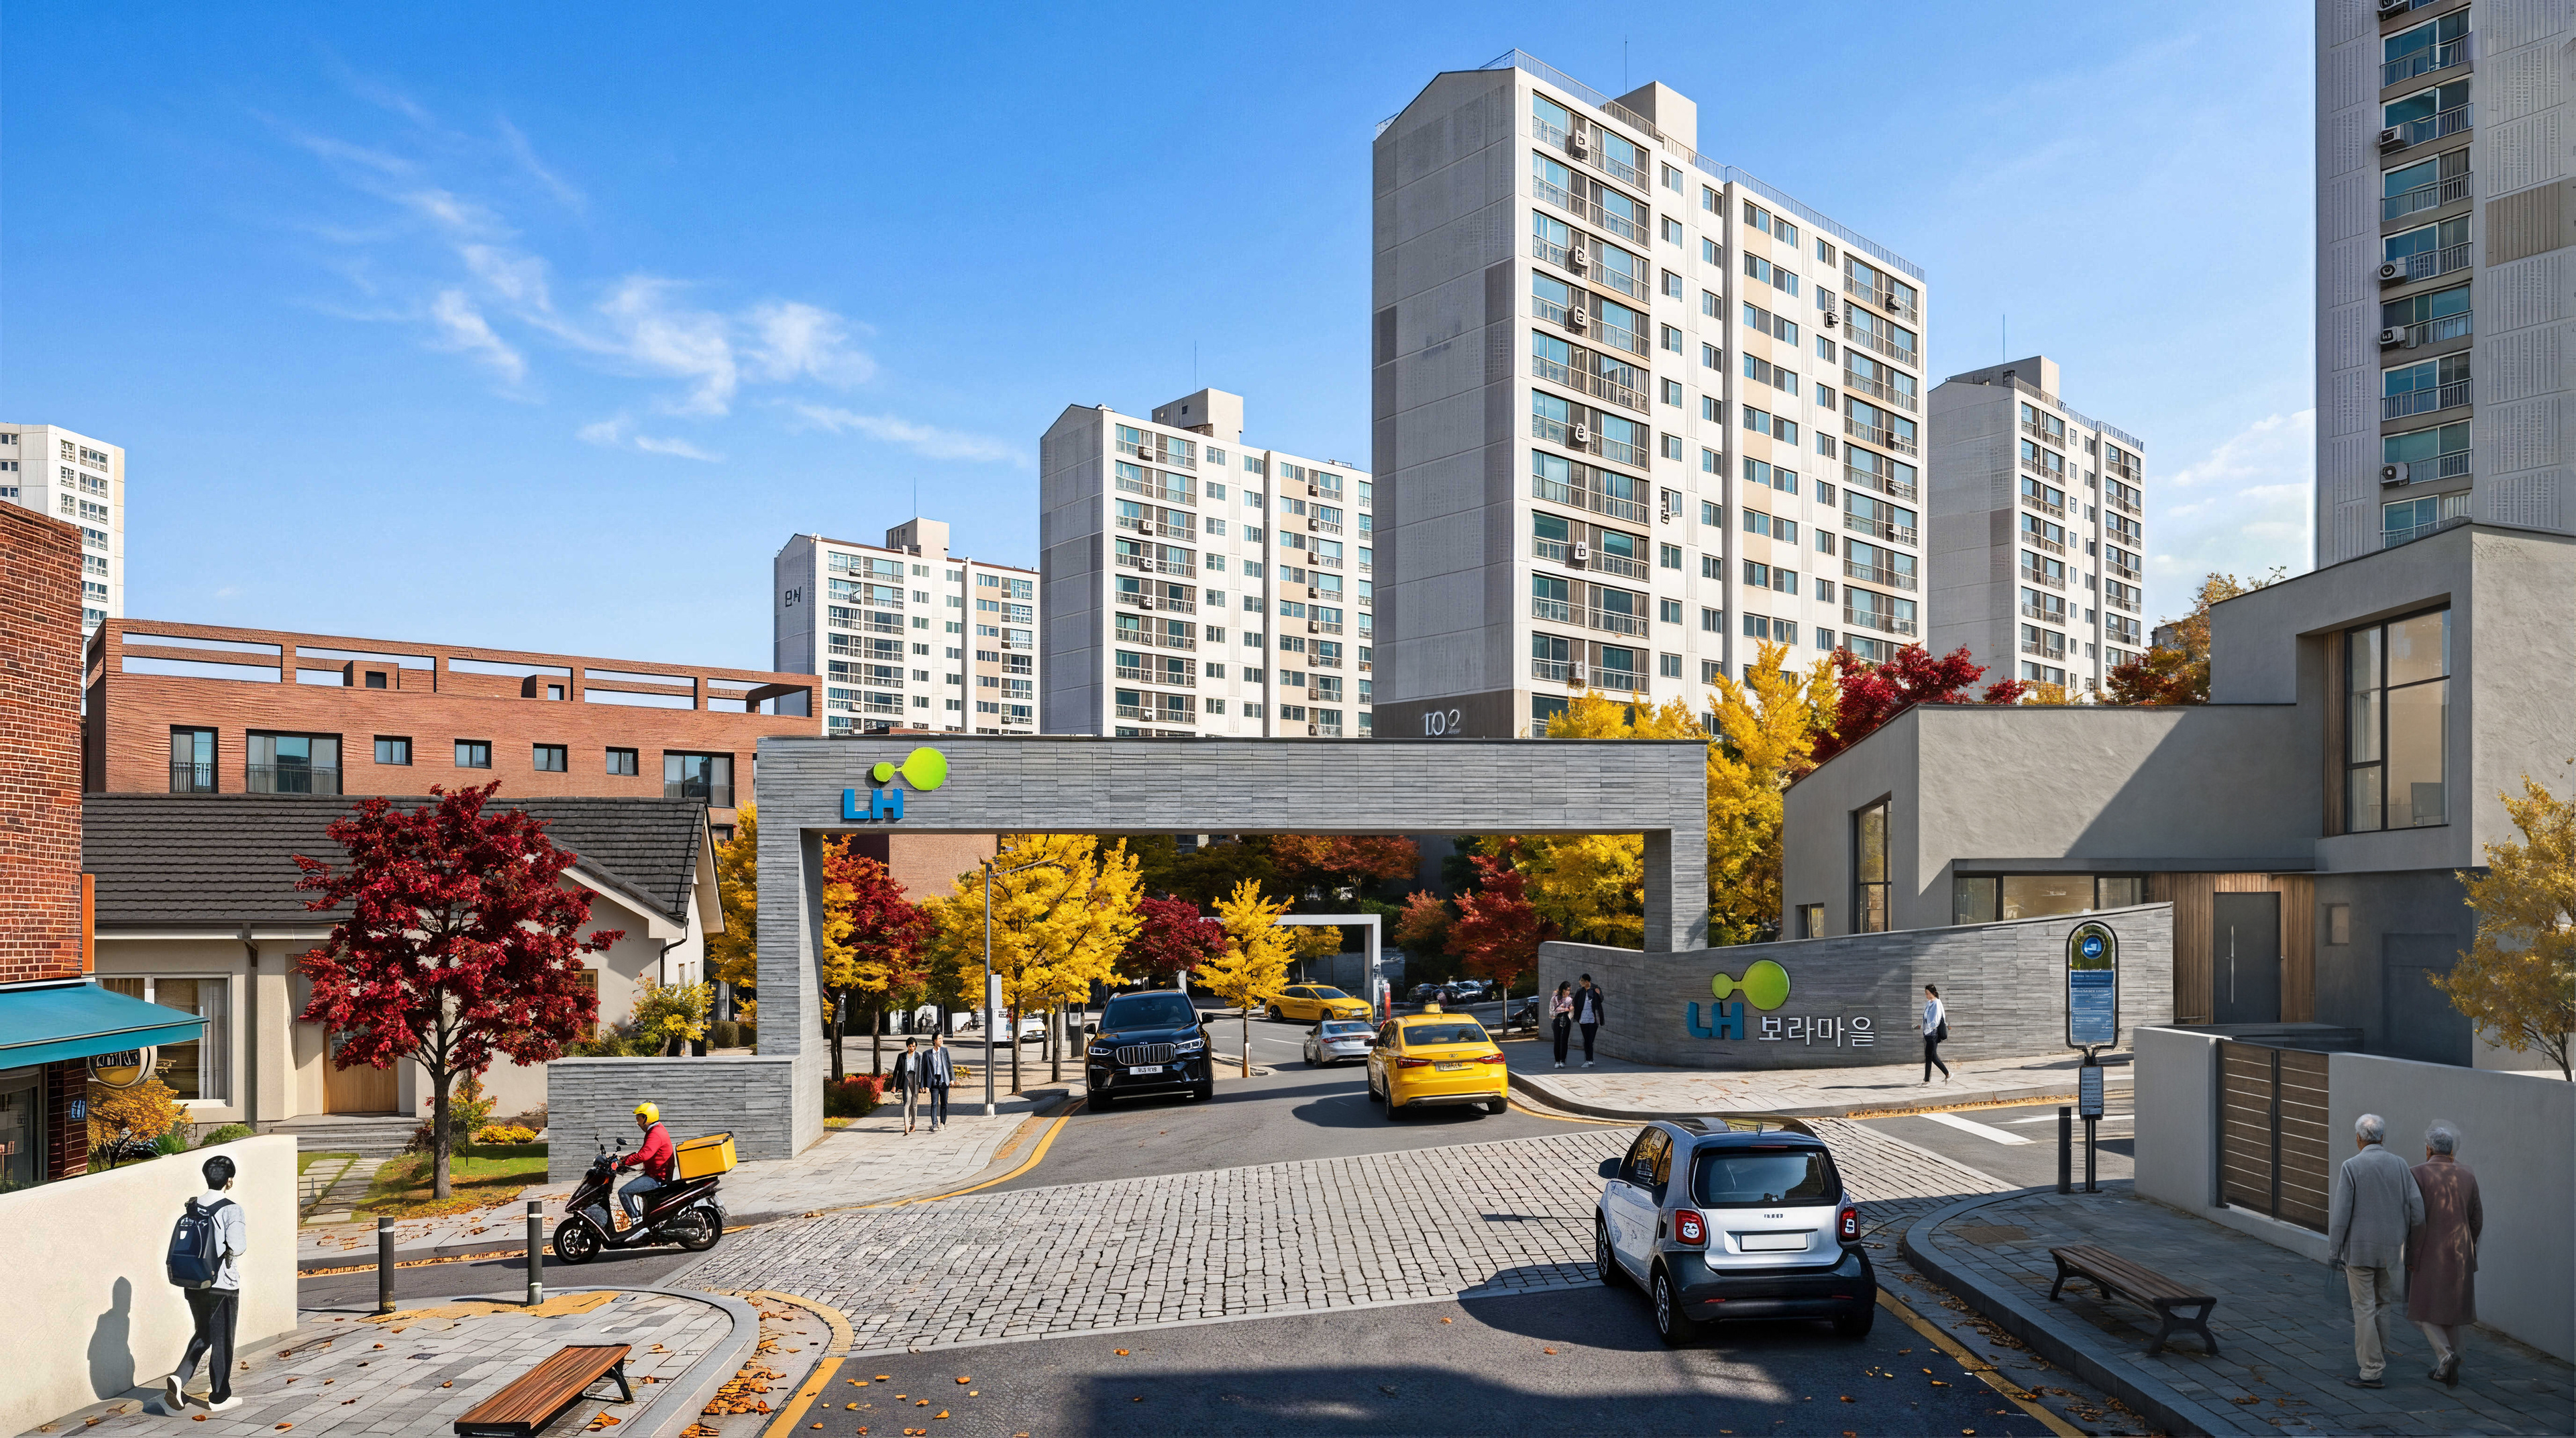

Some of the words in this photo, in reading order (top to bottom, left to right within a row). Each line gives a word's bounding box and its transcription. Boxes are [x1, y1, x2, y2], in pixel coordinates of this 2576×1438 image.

[843, 788, 904, 819] LH
[1687, 1001, 1744, 1039] LH
[1758, 1016, 1875, 1047] 보라마을
